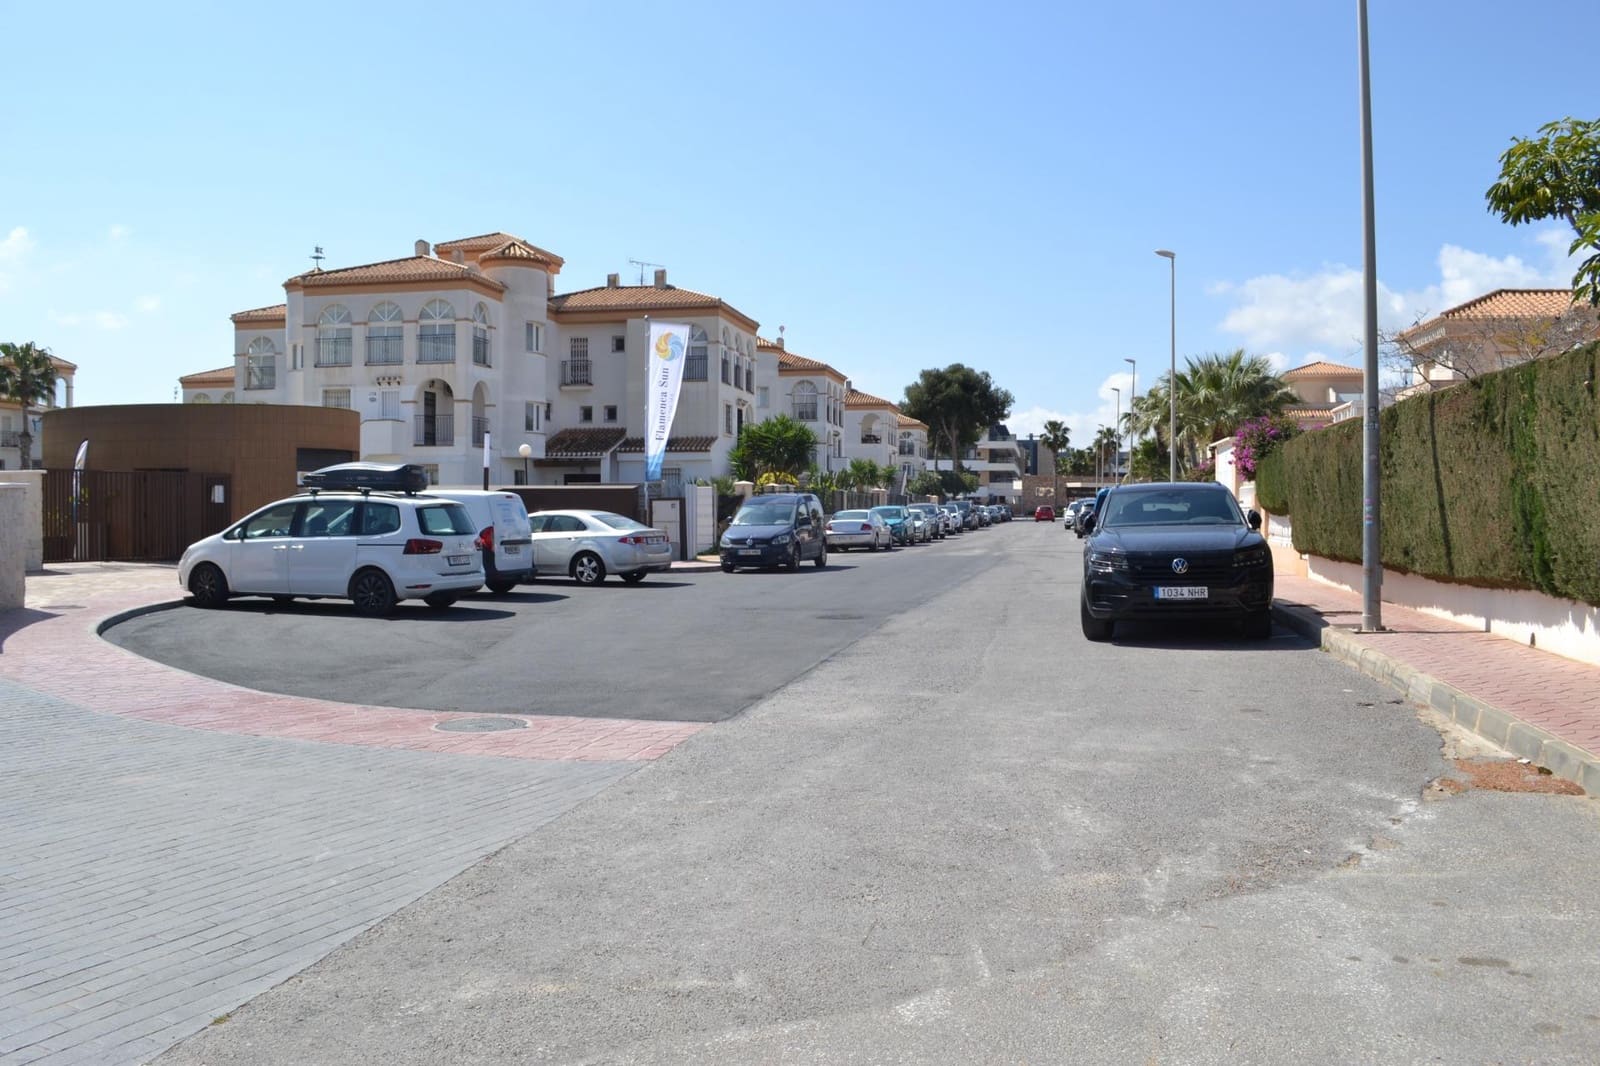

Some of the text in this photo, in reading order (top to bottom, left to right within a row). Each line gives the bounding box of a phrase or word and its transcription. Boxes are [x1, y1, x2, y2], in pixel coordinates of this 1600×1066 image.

[655, 367, 669, 441] Flamenca Sun
[1162, 588, 1206, 597] 1034 NHR
